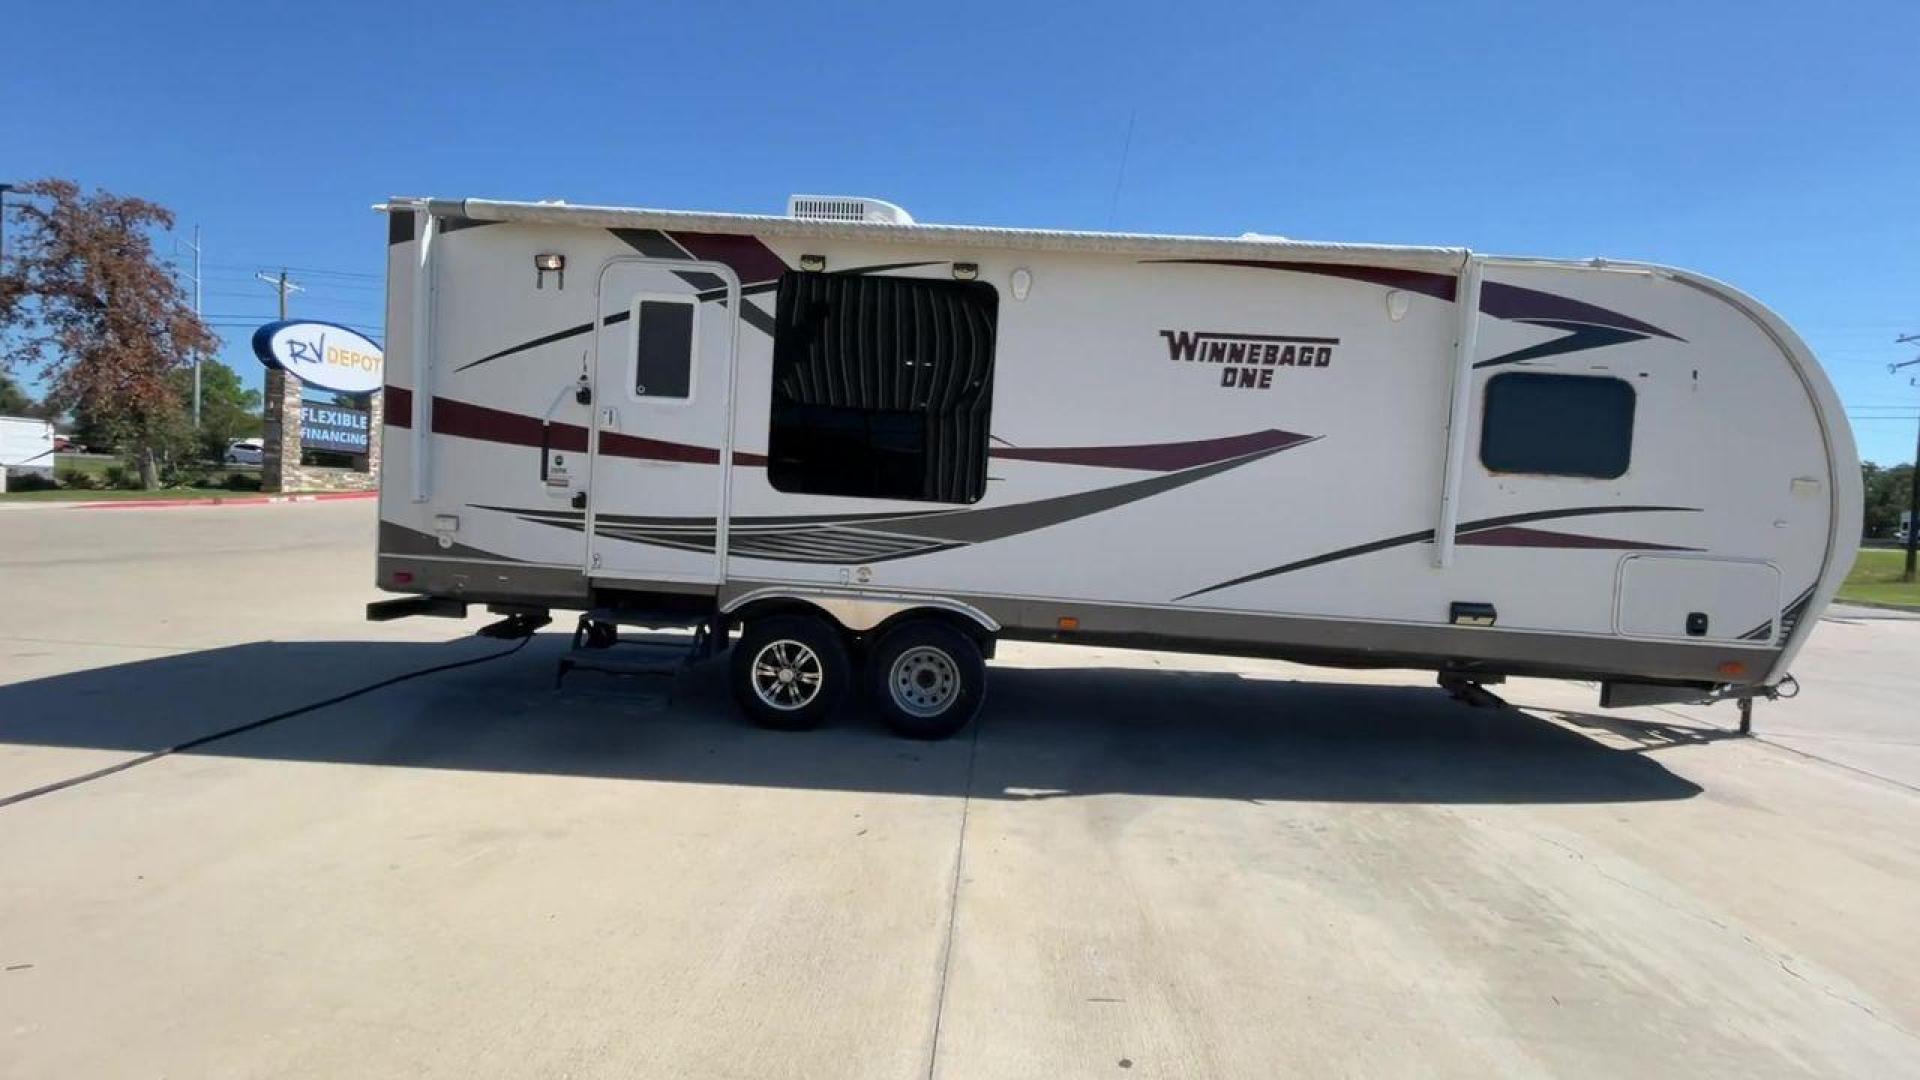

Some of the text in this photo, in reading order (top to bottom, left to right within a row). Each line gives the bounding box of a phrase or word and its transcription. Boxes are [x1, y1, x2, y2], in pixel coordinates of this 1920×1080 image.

[286, 332, 382, 372] RV DEPOT
[1159, 329, 1340, 367] WINNEBAGO
[1220, 366, 1274, 389] ONE
[301, 407, 368, 430] FLEXIBLE
[301, 427, 367, 446] FINANCING
